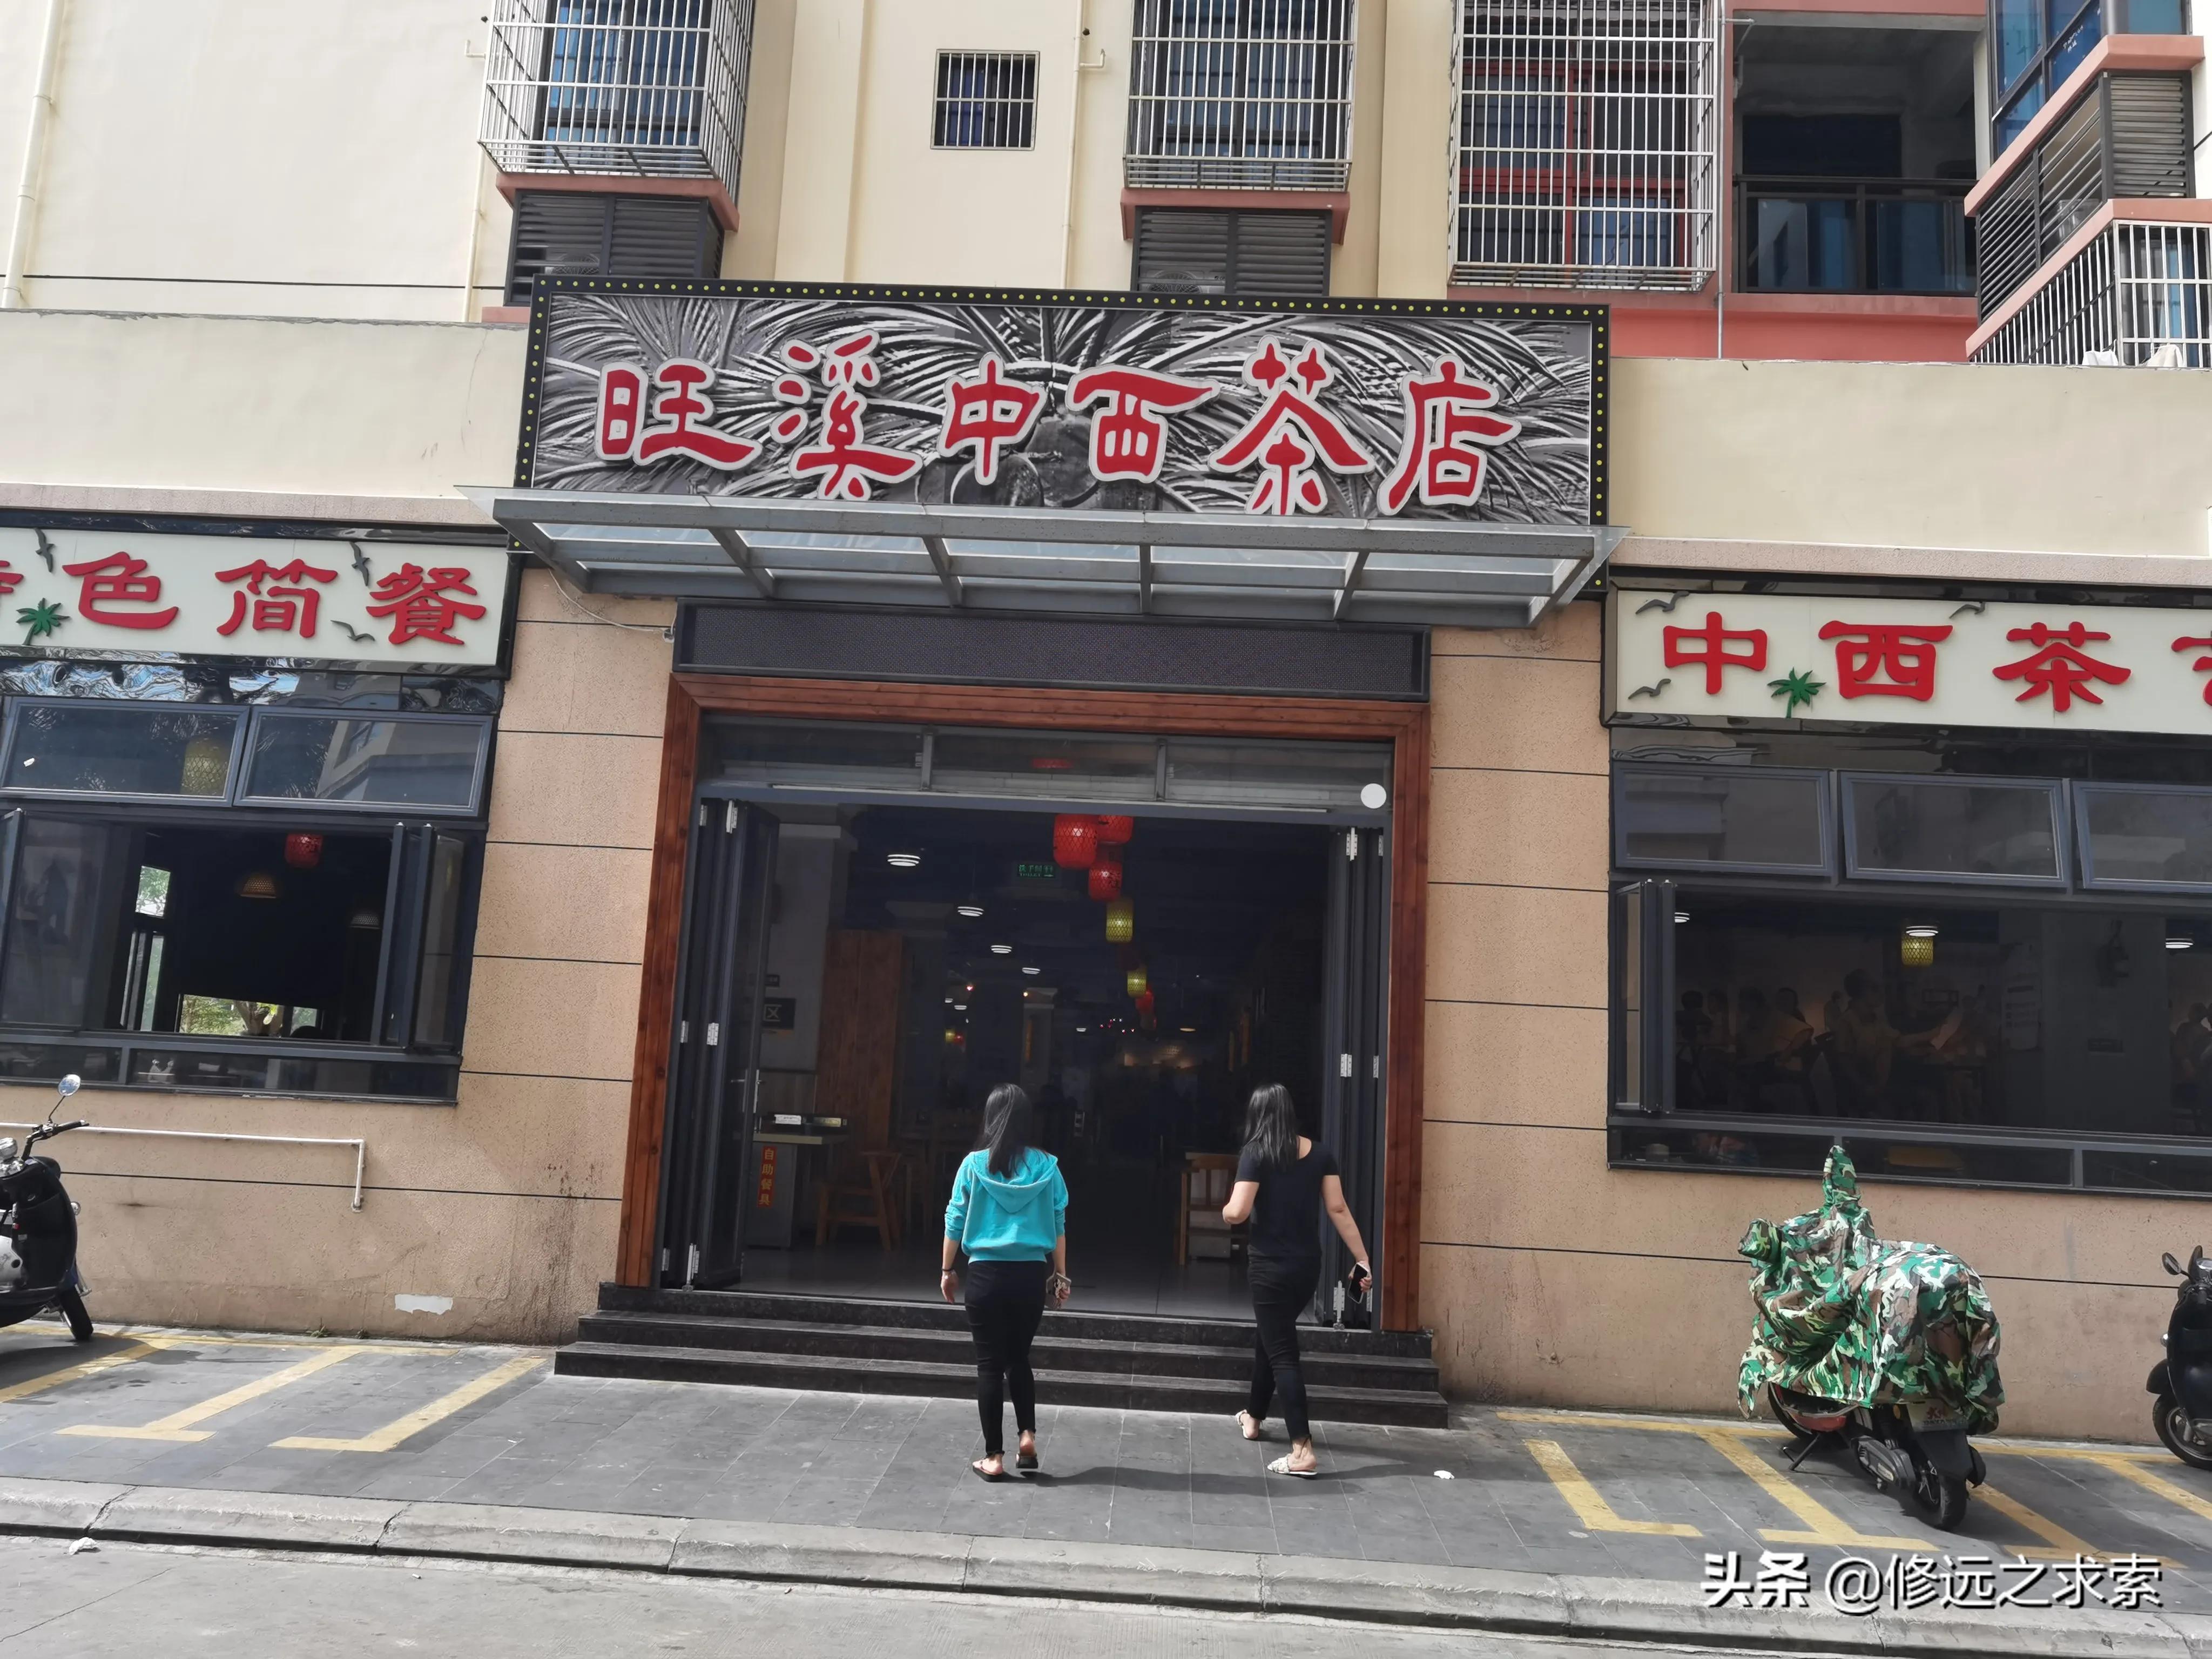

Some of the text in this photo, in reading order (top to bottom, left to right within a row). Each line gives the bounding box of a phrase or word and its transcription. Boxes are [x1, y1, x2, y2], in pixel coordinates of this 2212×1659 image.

[598, 331, 1520, 517] 旺溪中西茶店
[0, 552, 486, 645] 色简餐
[1663, 611, 2212, 712] 中西茶
[758, 1148, 774, 1206] 自助餐具
